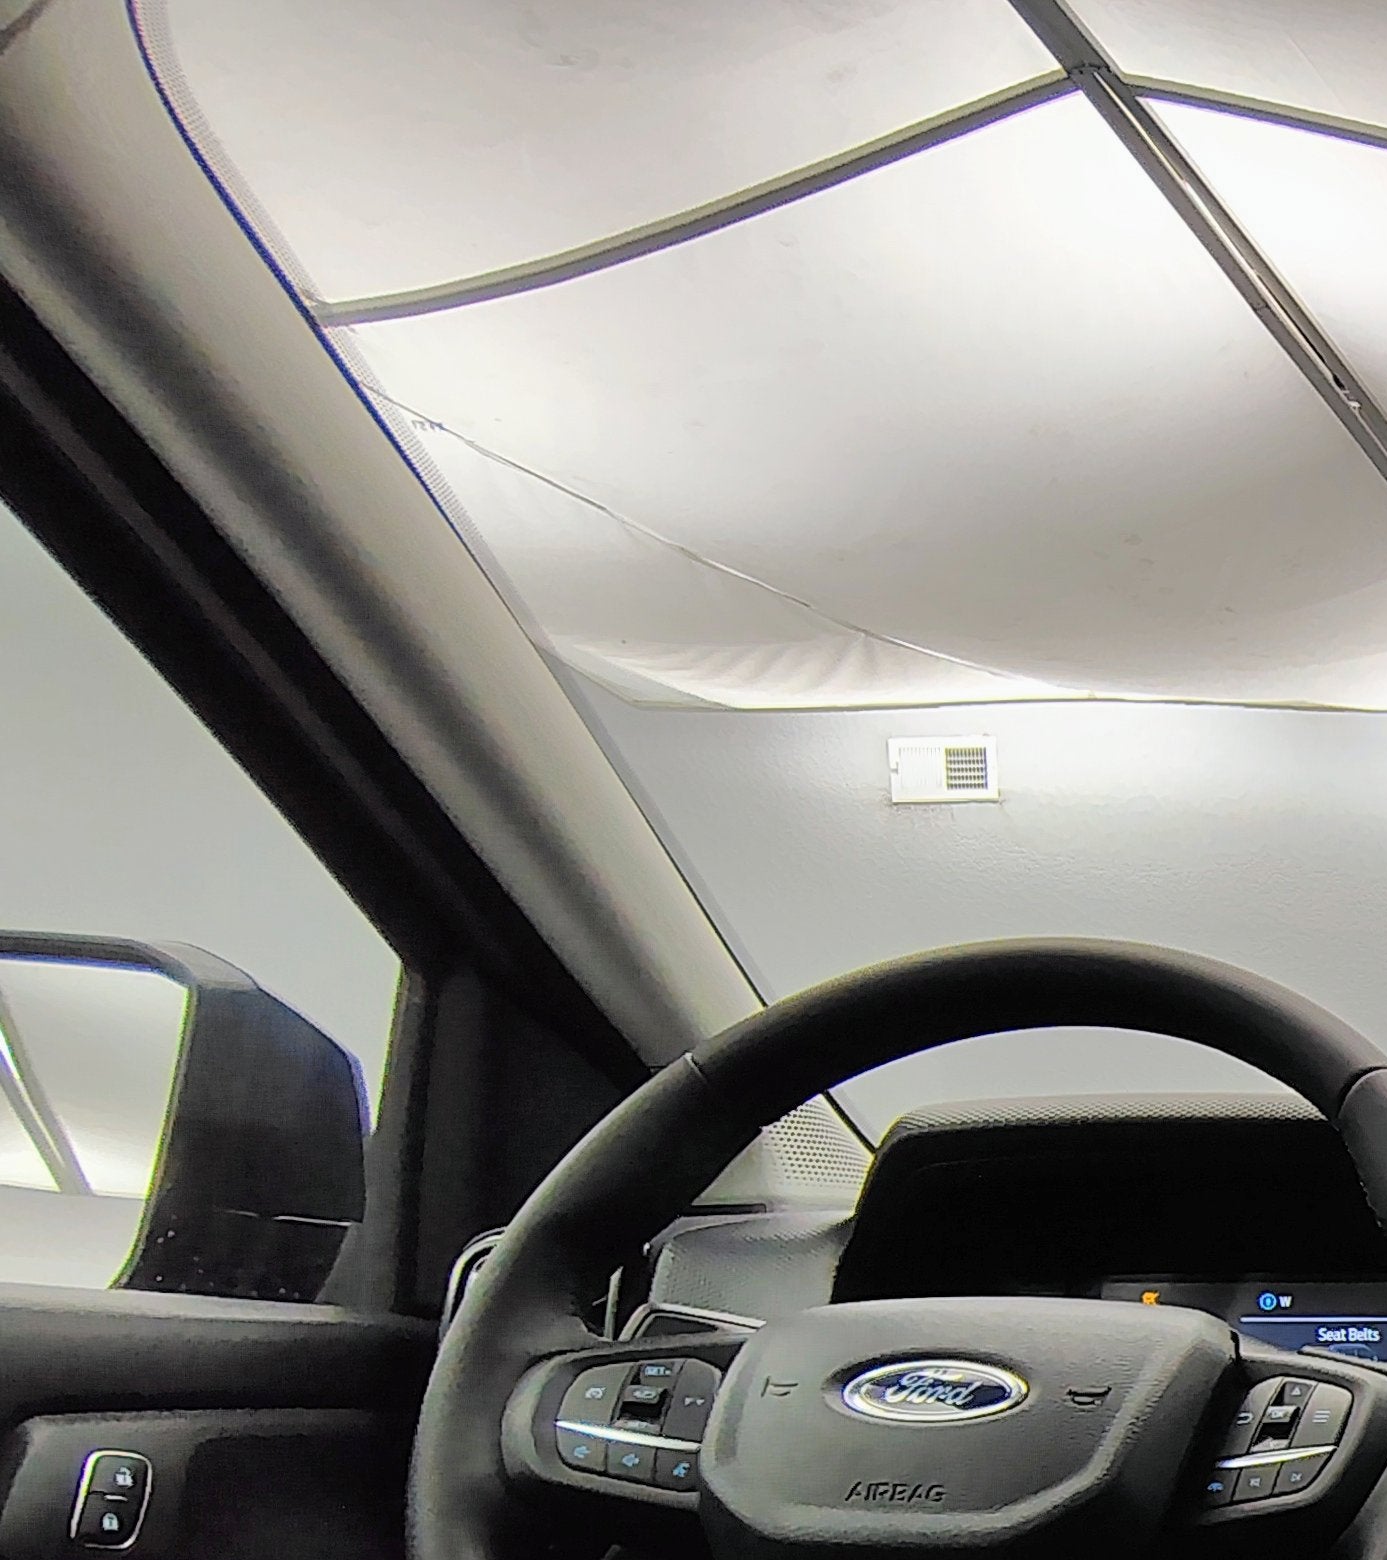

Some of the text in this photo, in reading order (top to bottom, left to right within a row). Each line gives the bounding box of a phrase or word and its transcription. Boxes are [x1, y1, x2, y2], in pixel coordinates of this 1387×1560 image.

[1317, 1326, 1381, 1343] Seat Belts
[884, 1367, 979, 1408] Ford
[844, 1480, 947, 1504] AIRBAG
